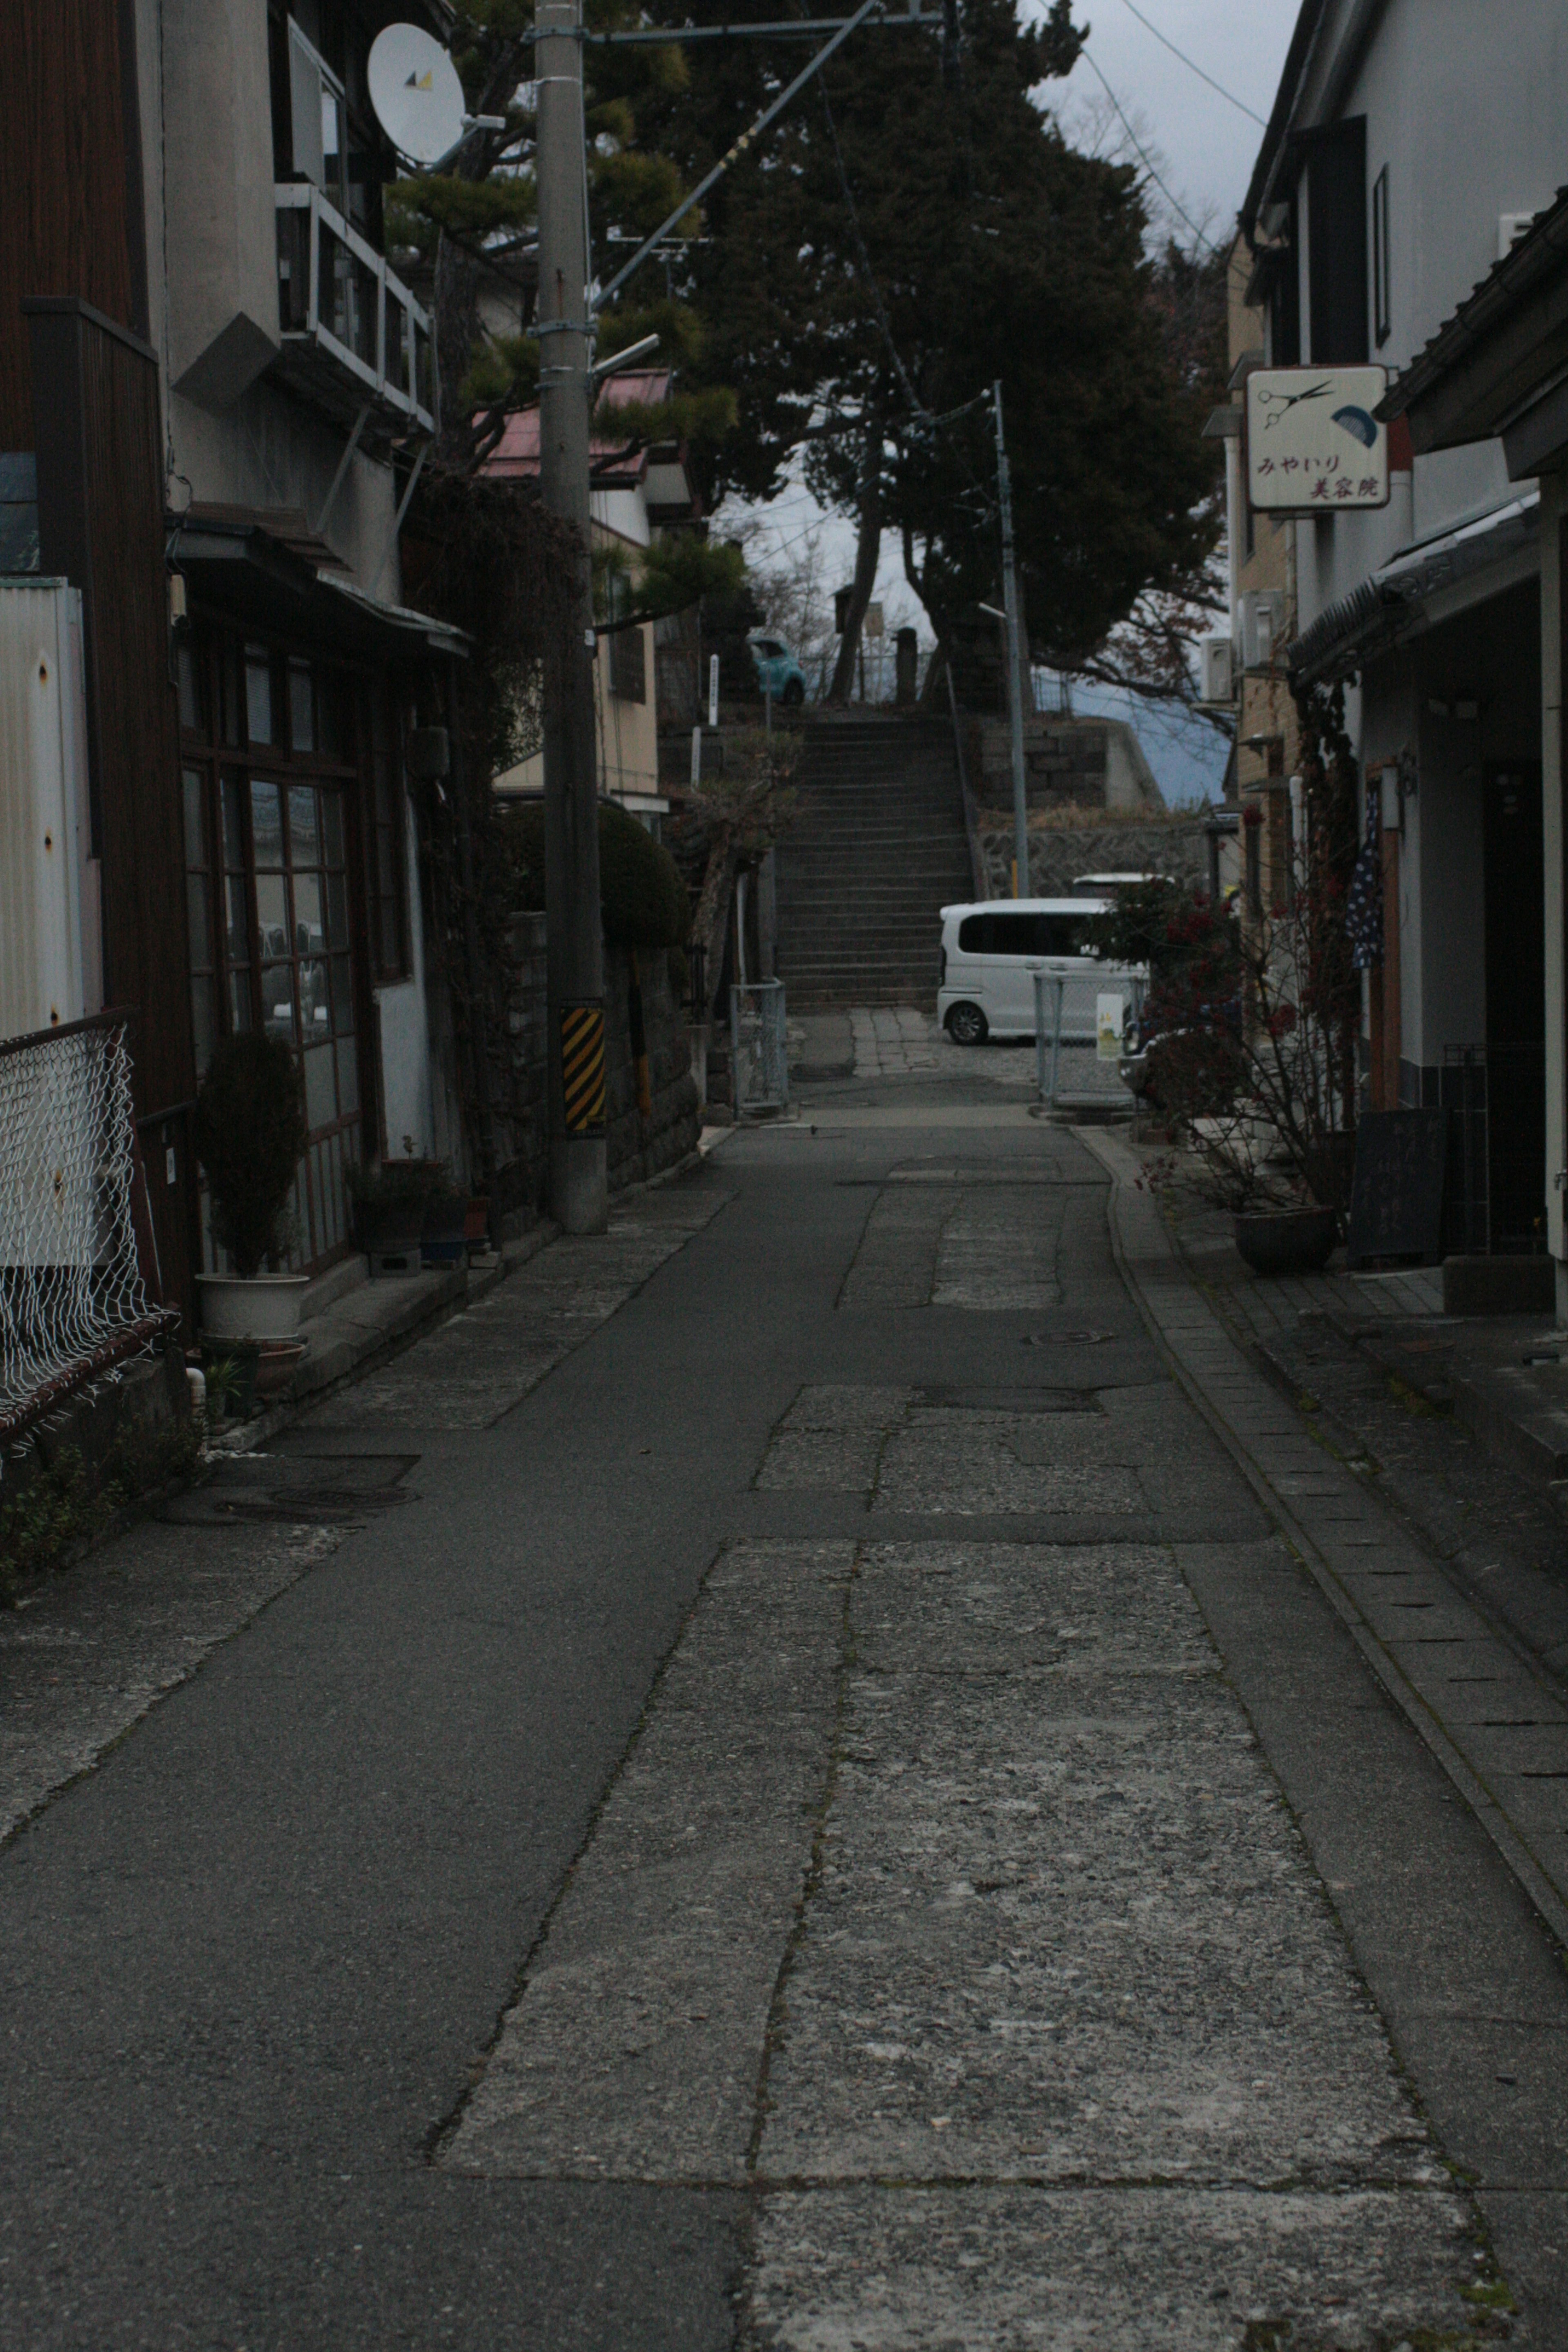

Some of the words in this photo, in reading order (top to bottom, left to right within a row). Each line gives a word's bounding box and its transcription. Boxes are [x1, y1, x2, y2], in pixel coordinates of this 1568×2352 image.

[1257, 455, 1340, 477] みやいり
[1311, 477, 1379, 500] 美容院
